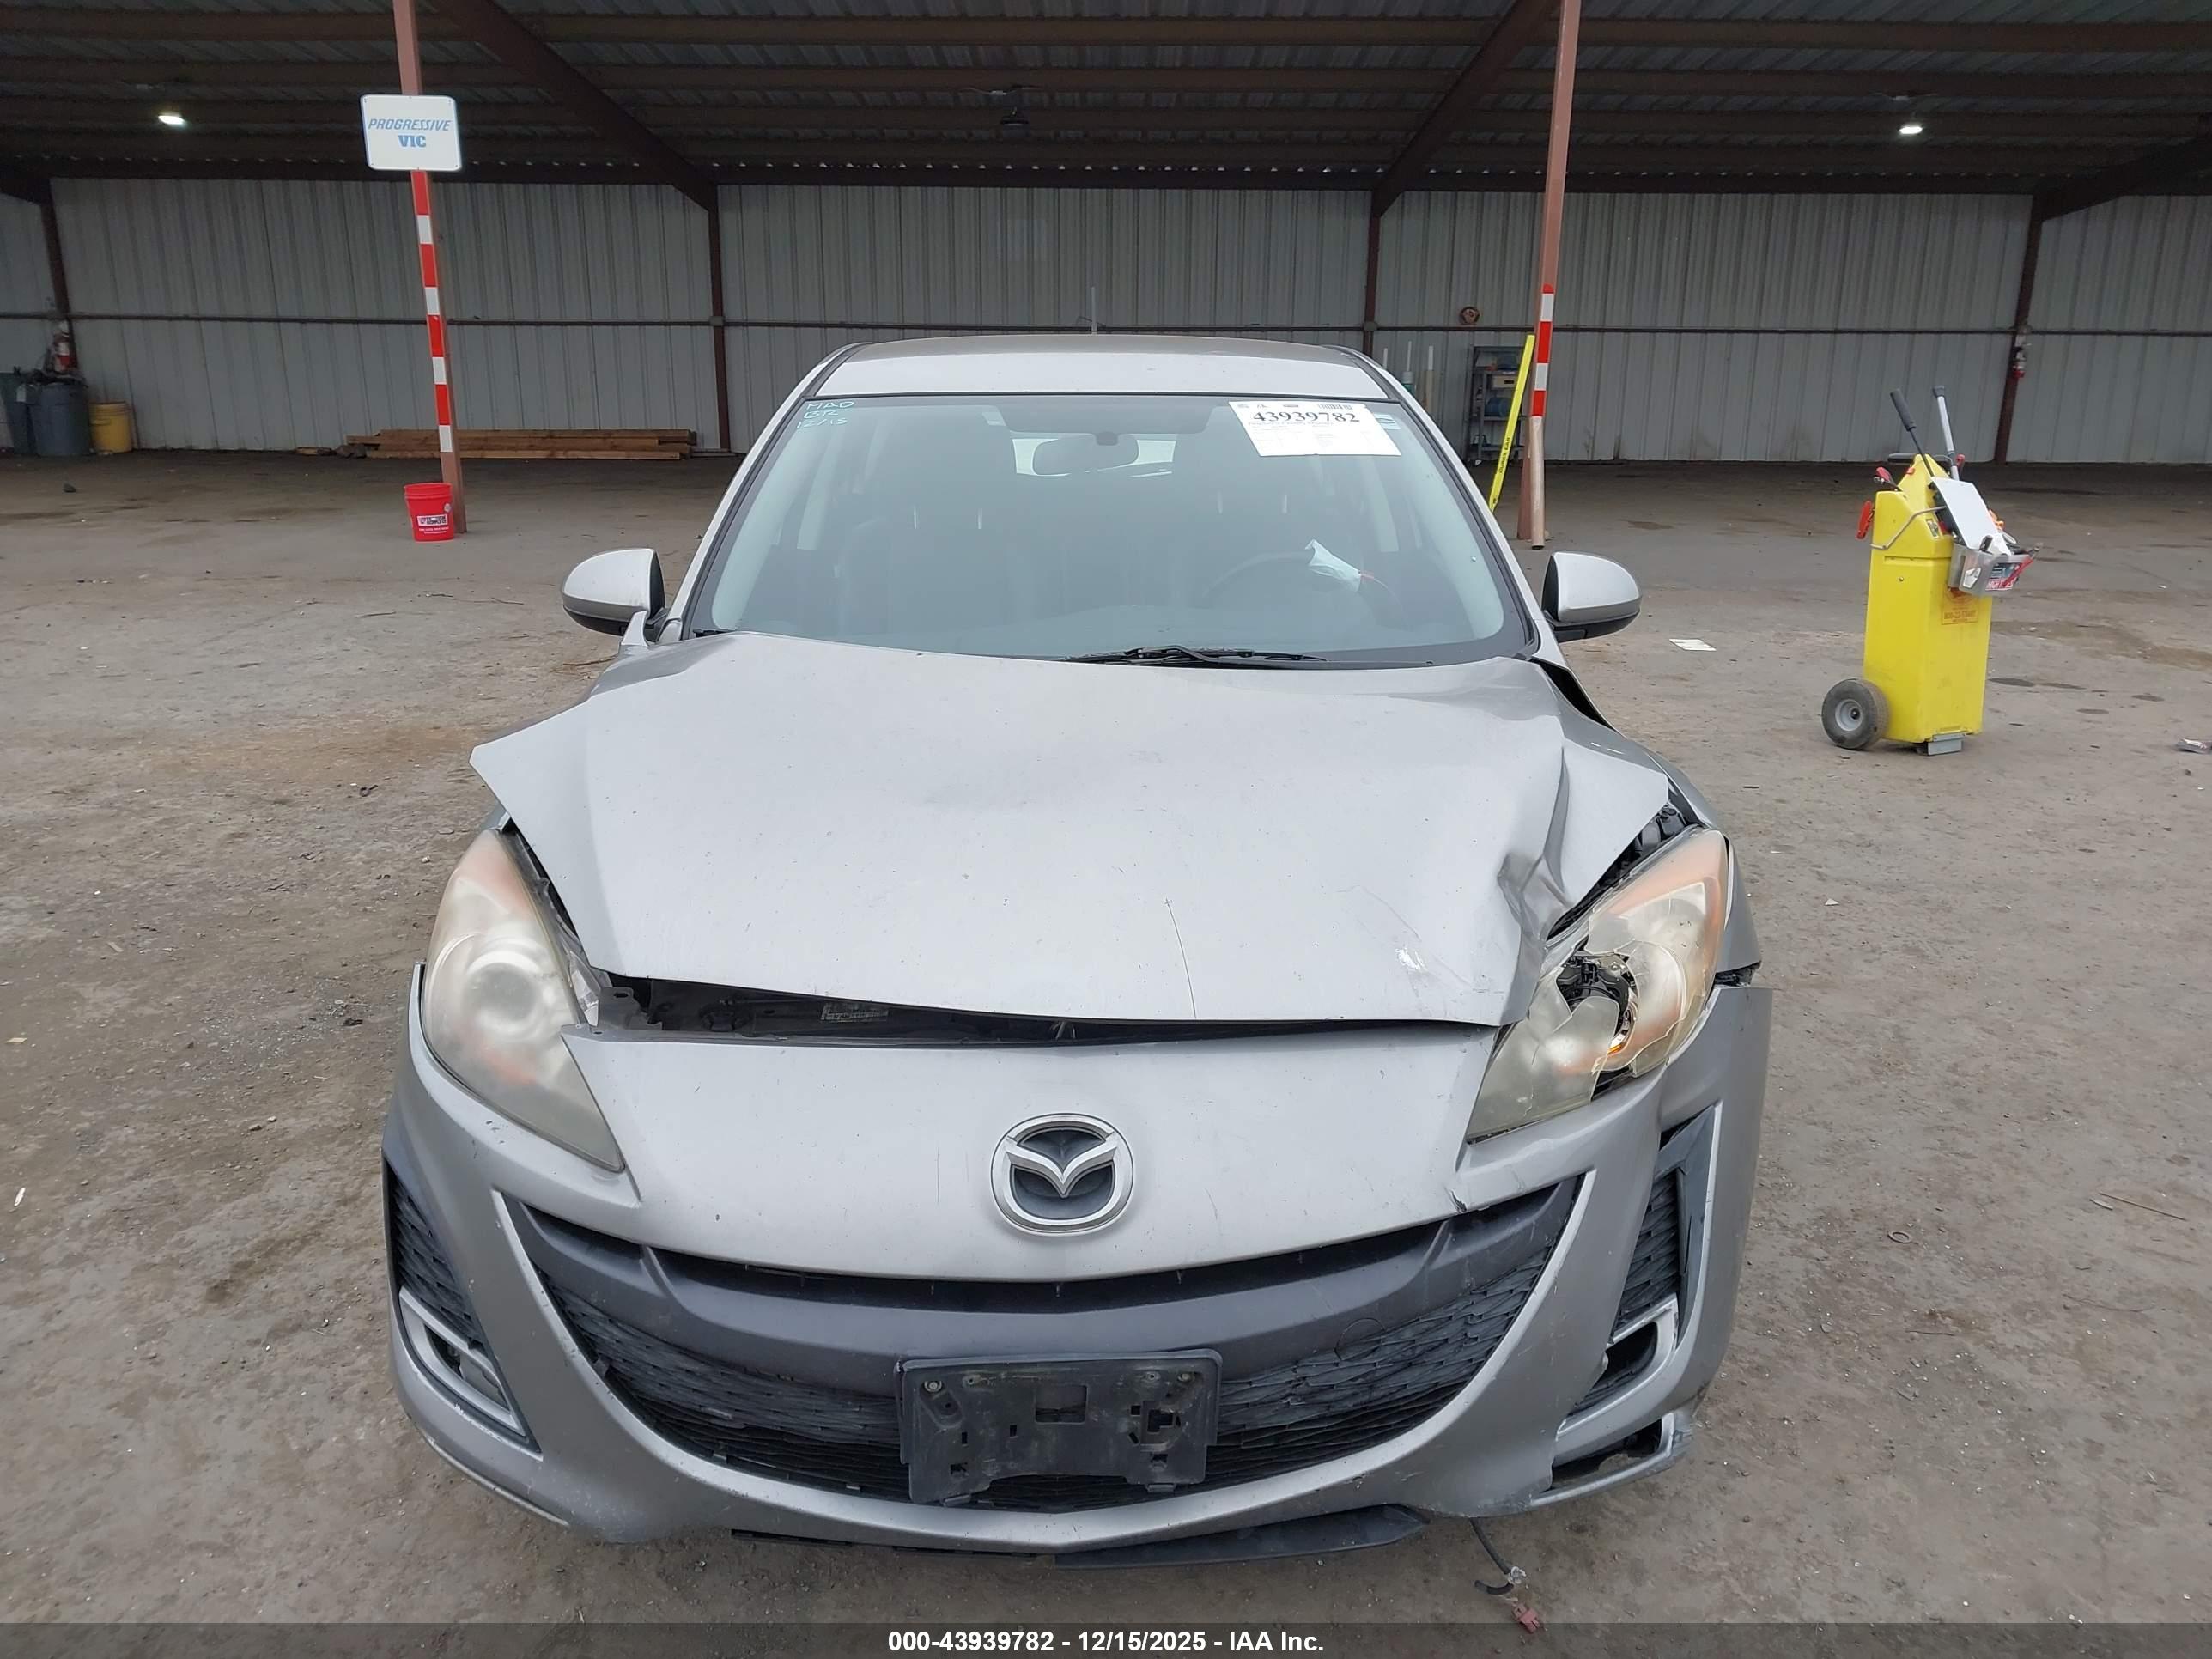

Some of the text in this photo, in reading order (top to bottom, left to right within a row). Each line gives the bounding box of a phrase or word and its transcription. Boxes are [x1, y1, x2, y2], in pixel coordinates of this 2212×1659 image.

[368, 118, 451, 131] PROGRESSIVE
[398, 134, 427, 148] VIC
[1253, 411, 1360, 422] 43939782
